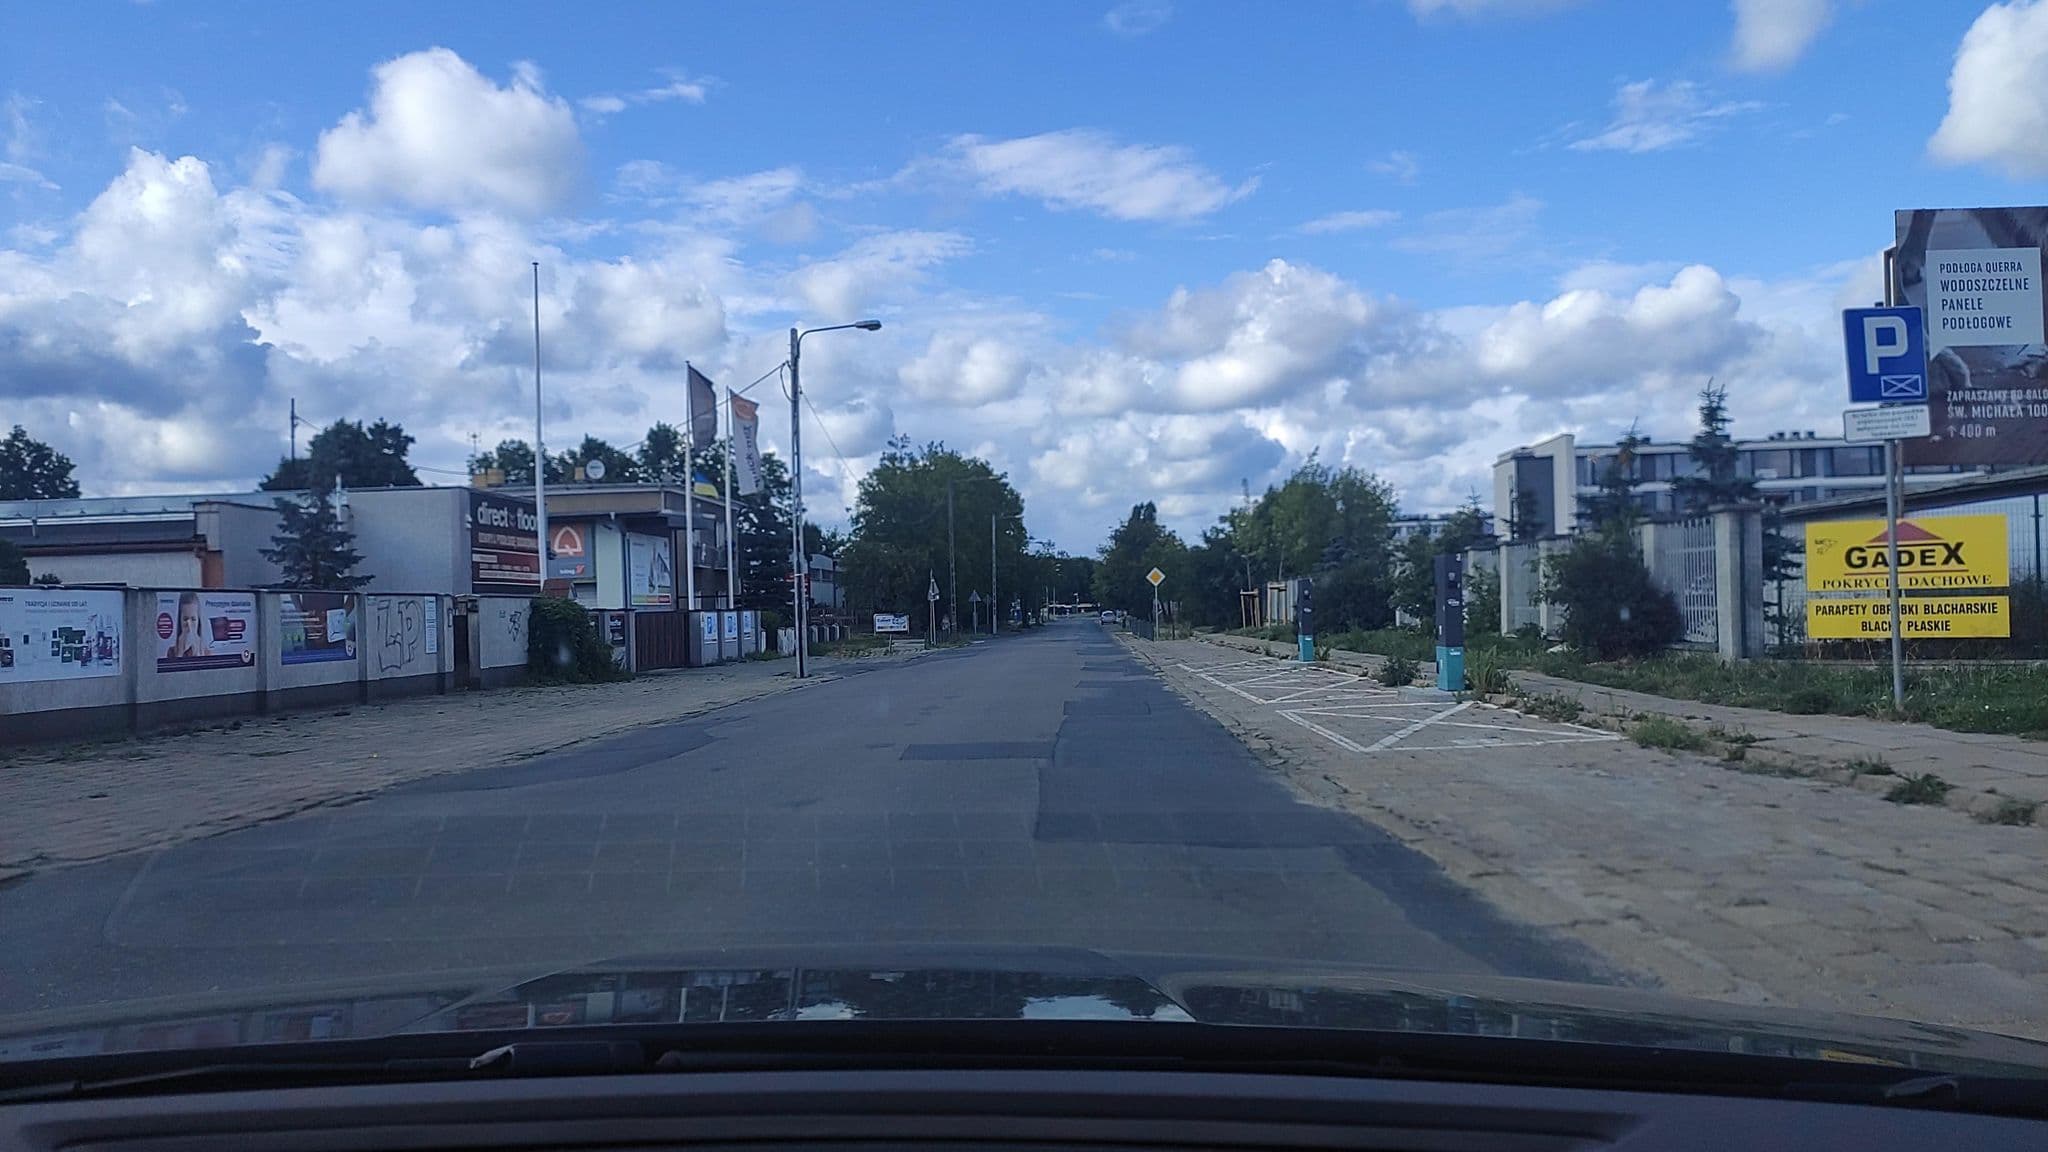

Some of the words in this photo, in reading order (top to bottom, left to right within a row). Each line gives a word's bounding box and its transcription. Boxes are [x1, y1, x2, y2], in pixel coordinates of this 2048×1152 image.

[1939, 263, 1983, 274] PODŁOGA
[1986, 262, 2023, 273] QUERRA
[1940, 278, 2029, 292] WODOSZCZELNE
[1941, 298, 1983, 311] PANELE
[1942, 316, 2013, 330] PODŁOGOWE
[1863, 315, 1908, 374] P
[1947, 390, 2008, 402] ZAPRASZAMY
[1947, 402, 1968, 418] ŚW.
[1972, 403, 2023, 418] MICHAŁA
[1985, 426, 1996, 437] m
[477, 501, 509, 528] direct
[516, 507, 538, 531] floo
[1845, 542, 1965, 569] GADEX
[1822, 577, 1899, 590] POKRYCI
[1908, 574, 1992, 587] DACHOWE
[1815, 604, 1867, 617] PARAPETY
[1872, 603, 1918, 616] OBRBKI
[1923, 602, 1999, 615] BLACHARSKIE
[1907, 620, 1951, 632] PŁASKIE
